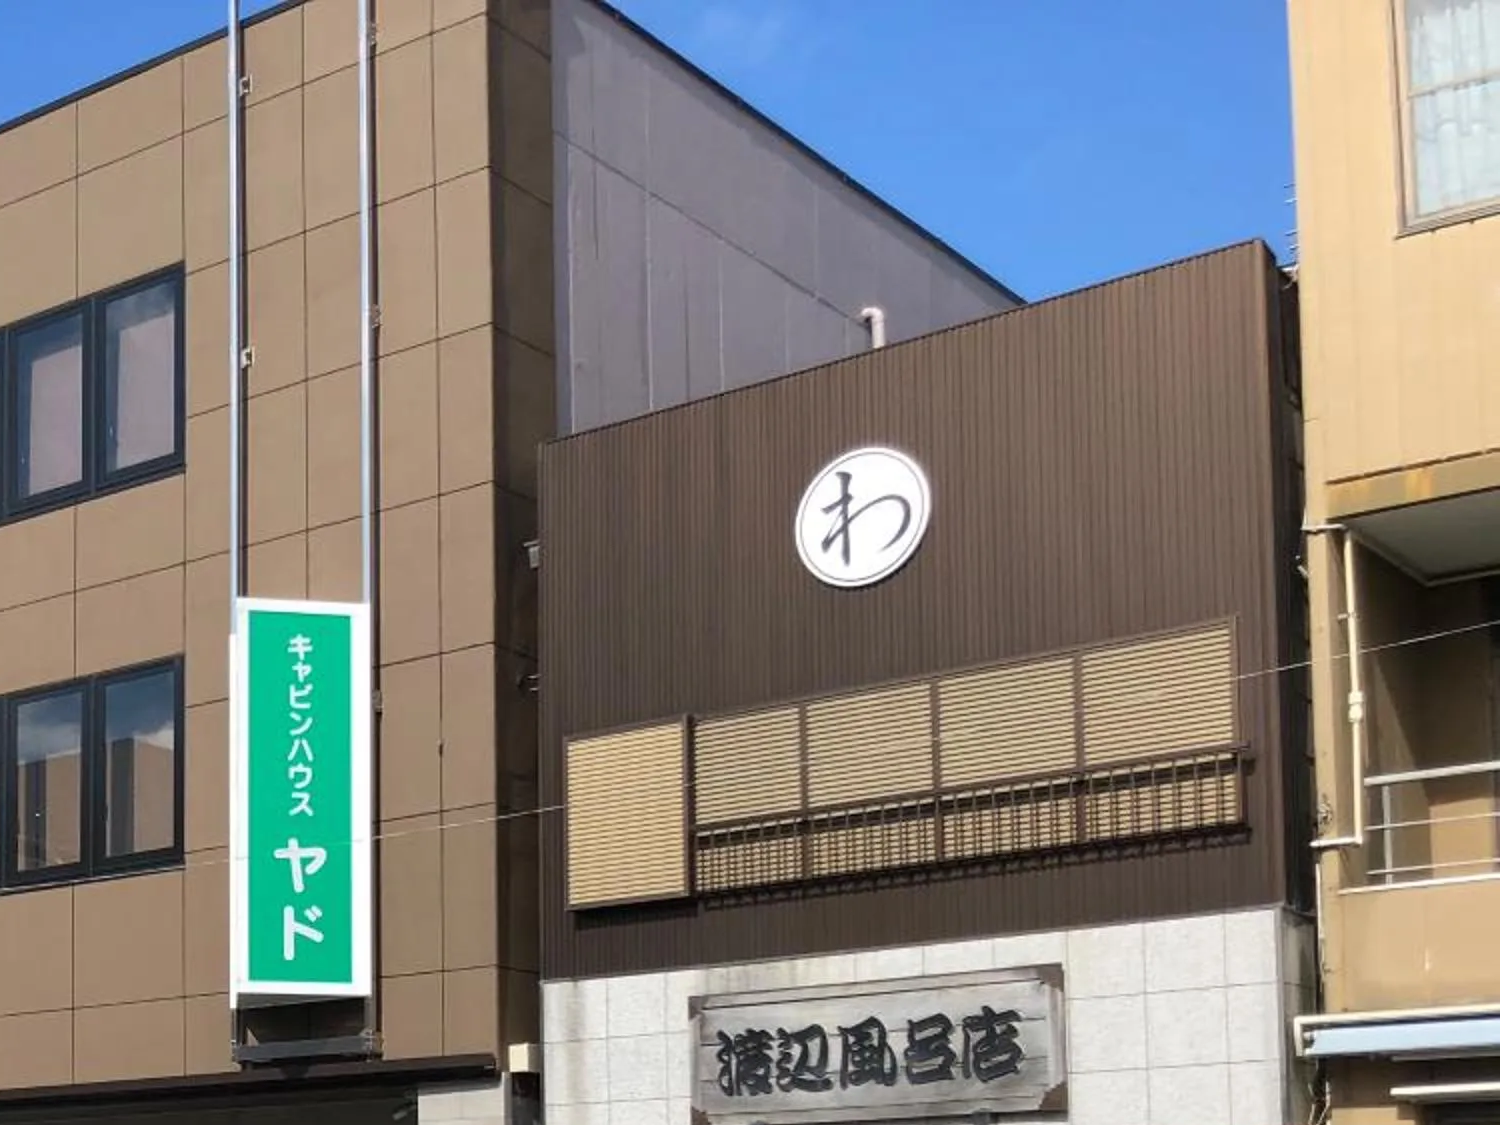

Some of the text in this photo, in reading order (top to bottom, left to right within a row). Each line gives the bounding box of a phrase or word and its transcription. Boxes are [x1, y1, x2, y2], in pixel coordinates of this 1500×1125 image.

[820, 471, 911, 567] わ
[273, 633, 328, 961] キャビンハウス ヤド
[715, 1005, 1026, 1097] 渡辺風呂店
